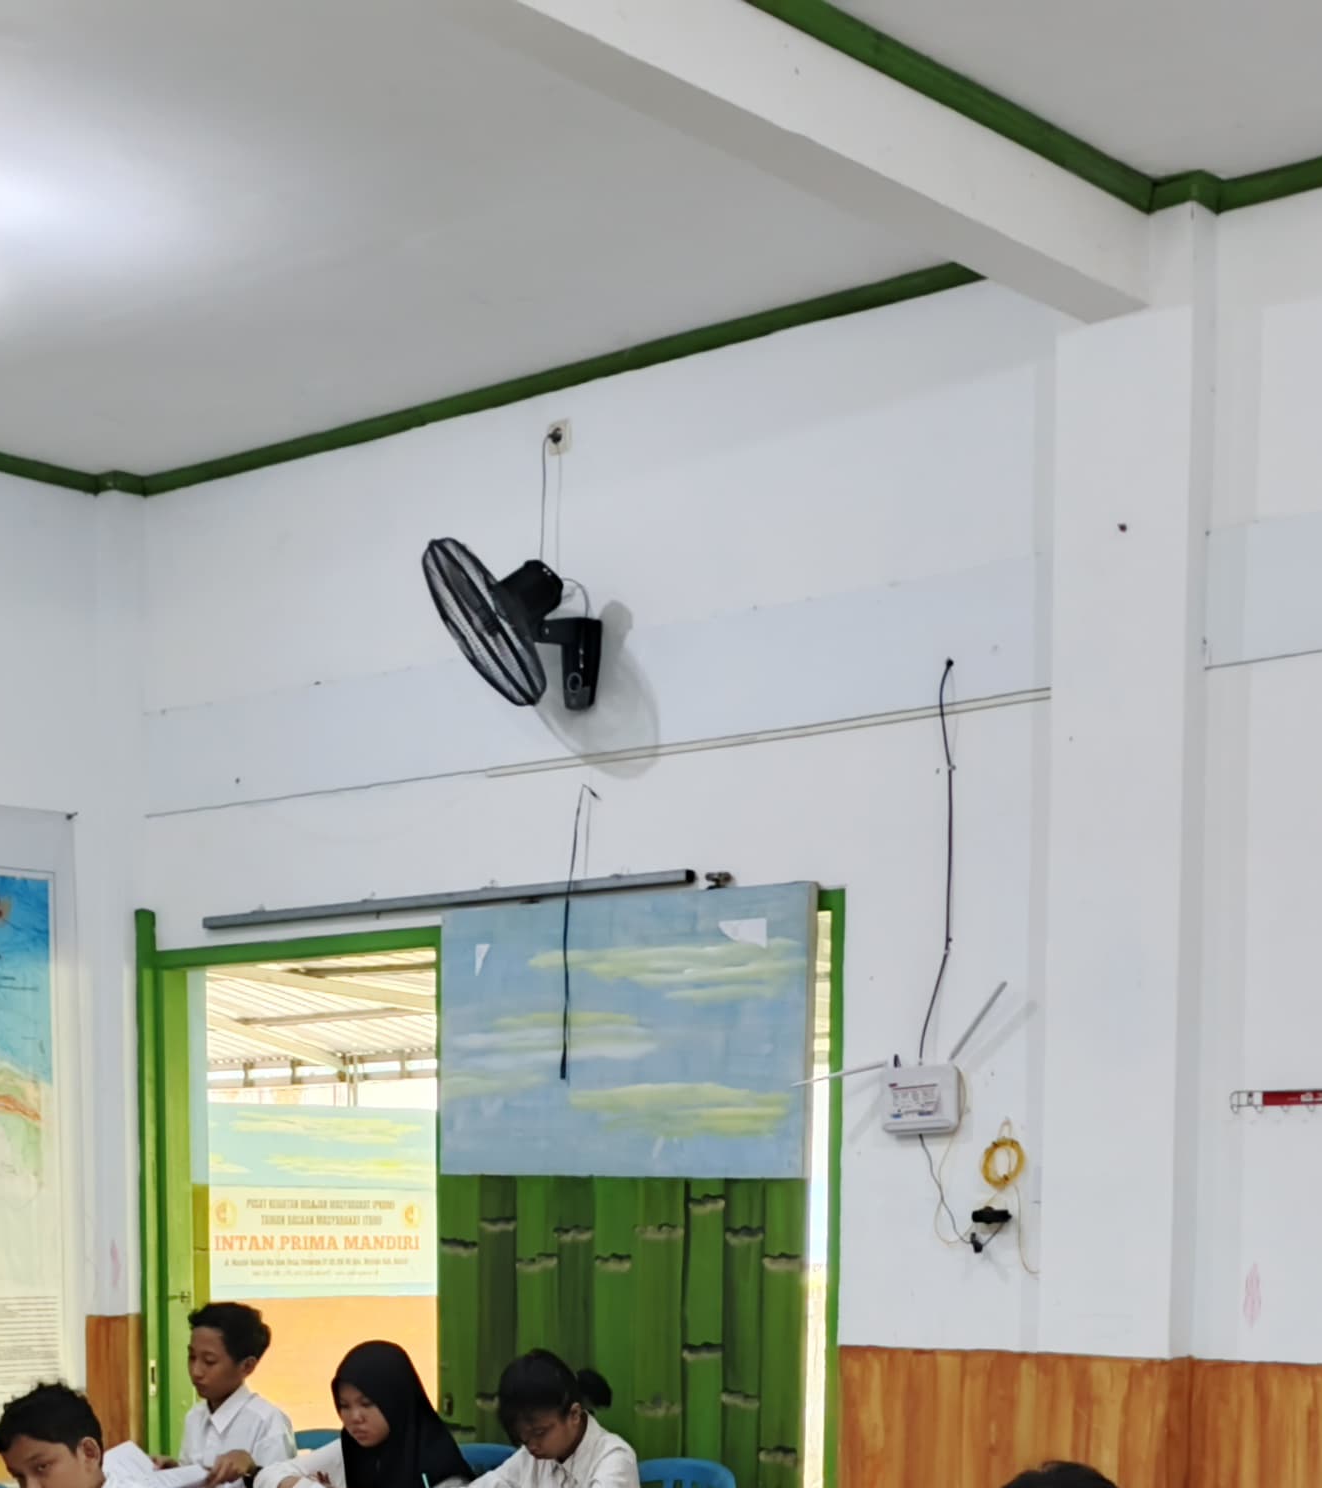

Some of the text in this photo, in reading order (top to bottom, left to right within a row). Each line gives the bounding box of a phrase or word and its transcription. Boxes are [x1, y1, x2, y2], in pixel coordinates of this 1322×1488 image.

[215, 1234, 420, 1251] INTAN PRIMA MANDIRI
